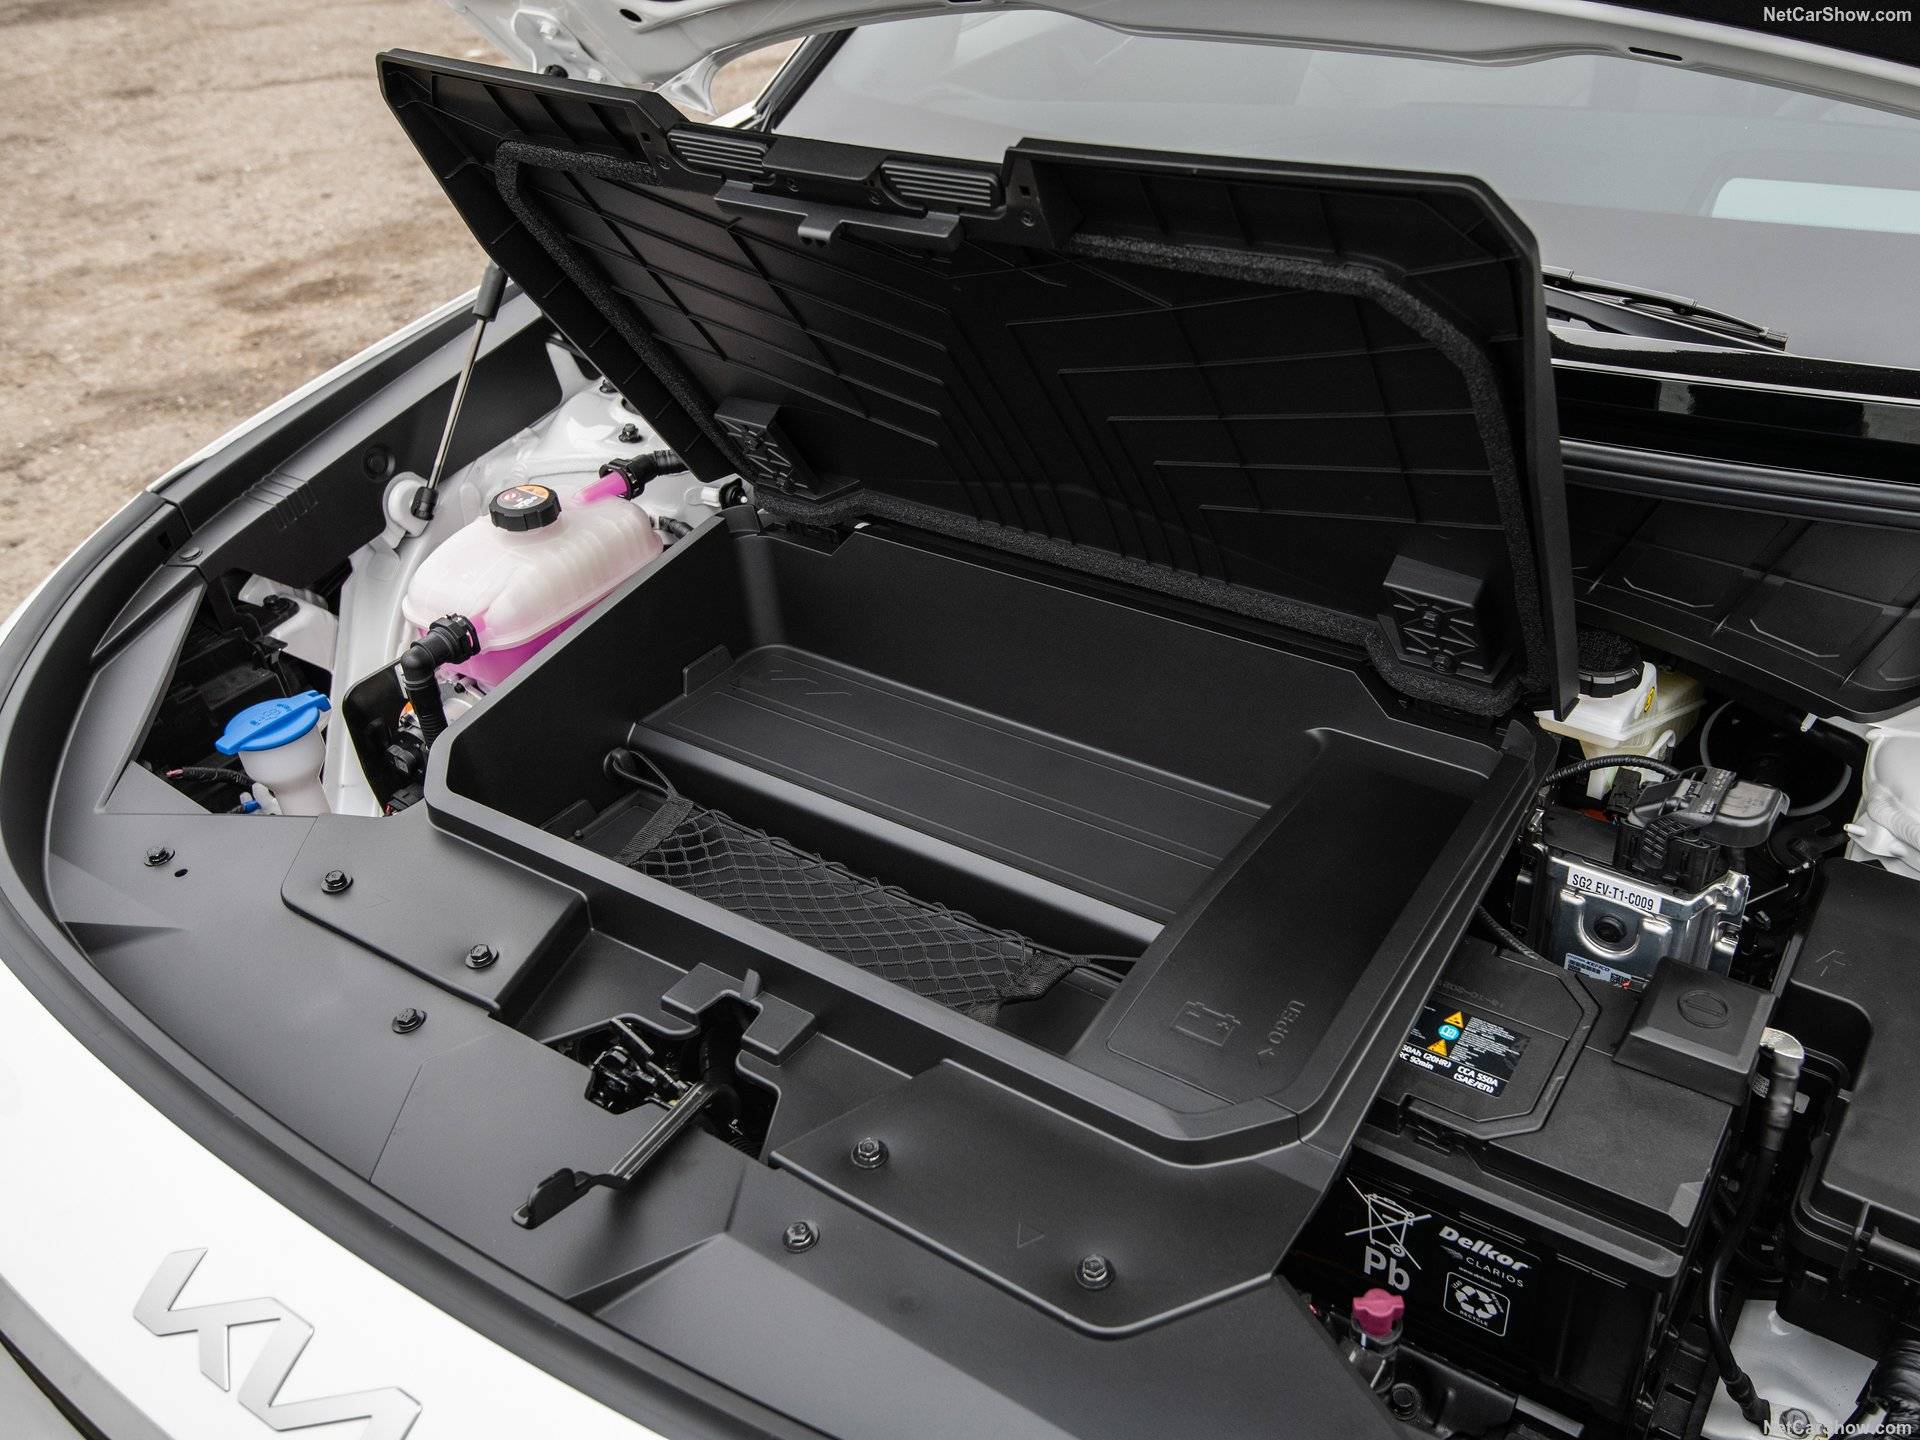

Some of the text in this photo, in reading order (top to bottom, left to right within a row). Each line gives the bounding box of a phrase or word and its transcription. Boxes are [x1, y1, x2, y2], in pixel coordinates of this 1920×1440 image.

[1572, 873, 1655, 911] SG2 EV-T1-C009
[1410, 1054, 1434, 1071] 92min
[1423, 1050, 1452, 1069] (20HR)
[1457, 1065, 1499, 1087] CCA 550A
[1439, 1225, 1529, 1271] Delkor
[1363, 1245, 1411, 1291] Pb
[1465, 1256, 1525, 1288] CLARIOS
